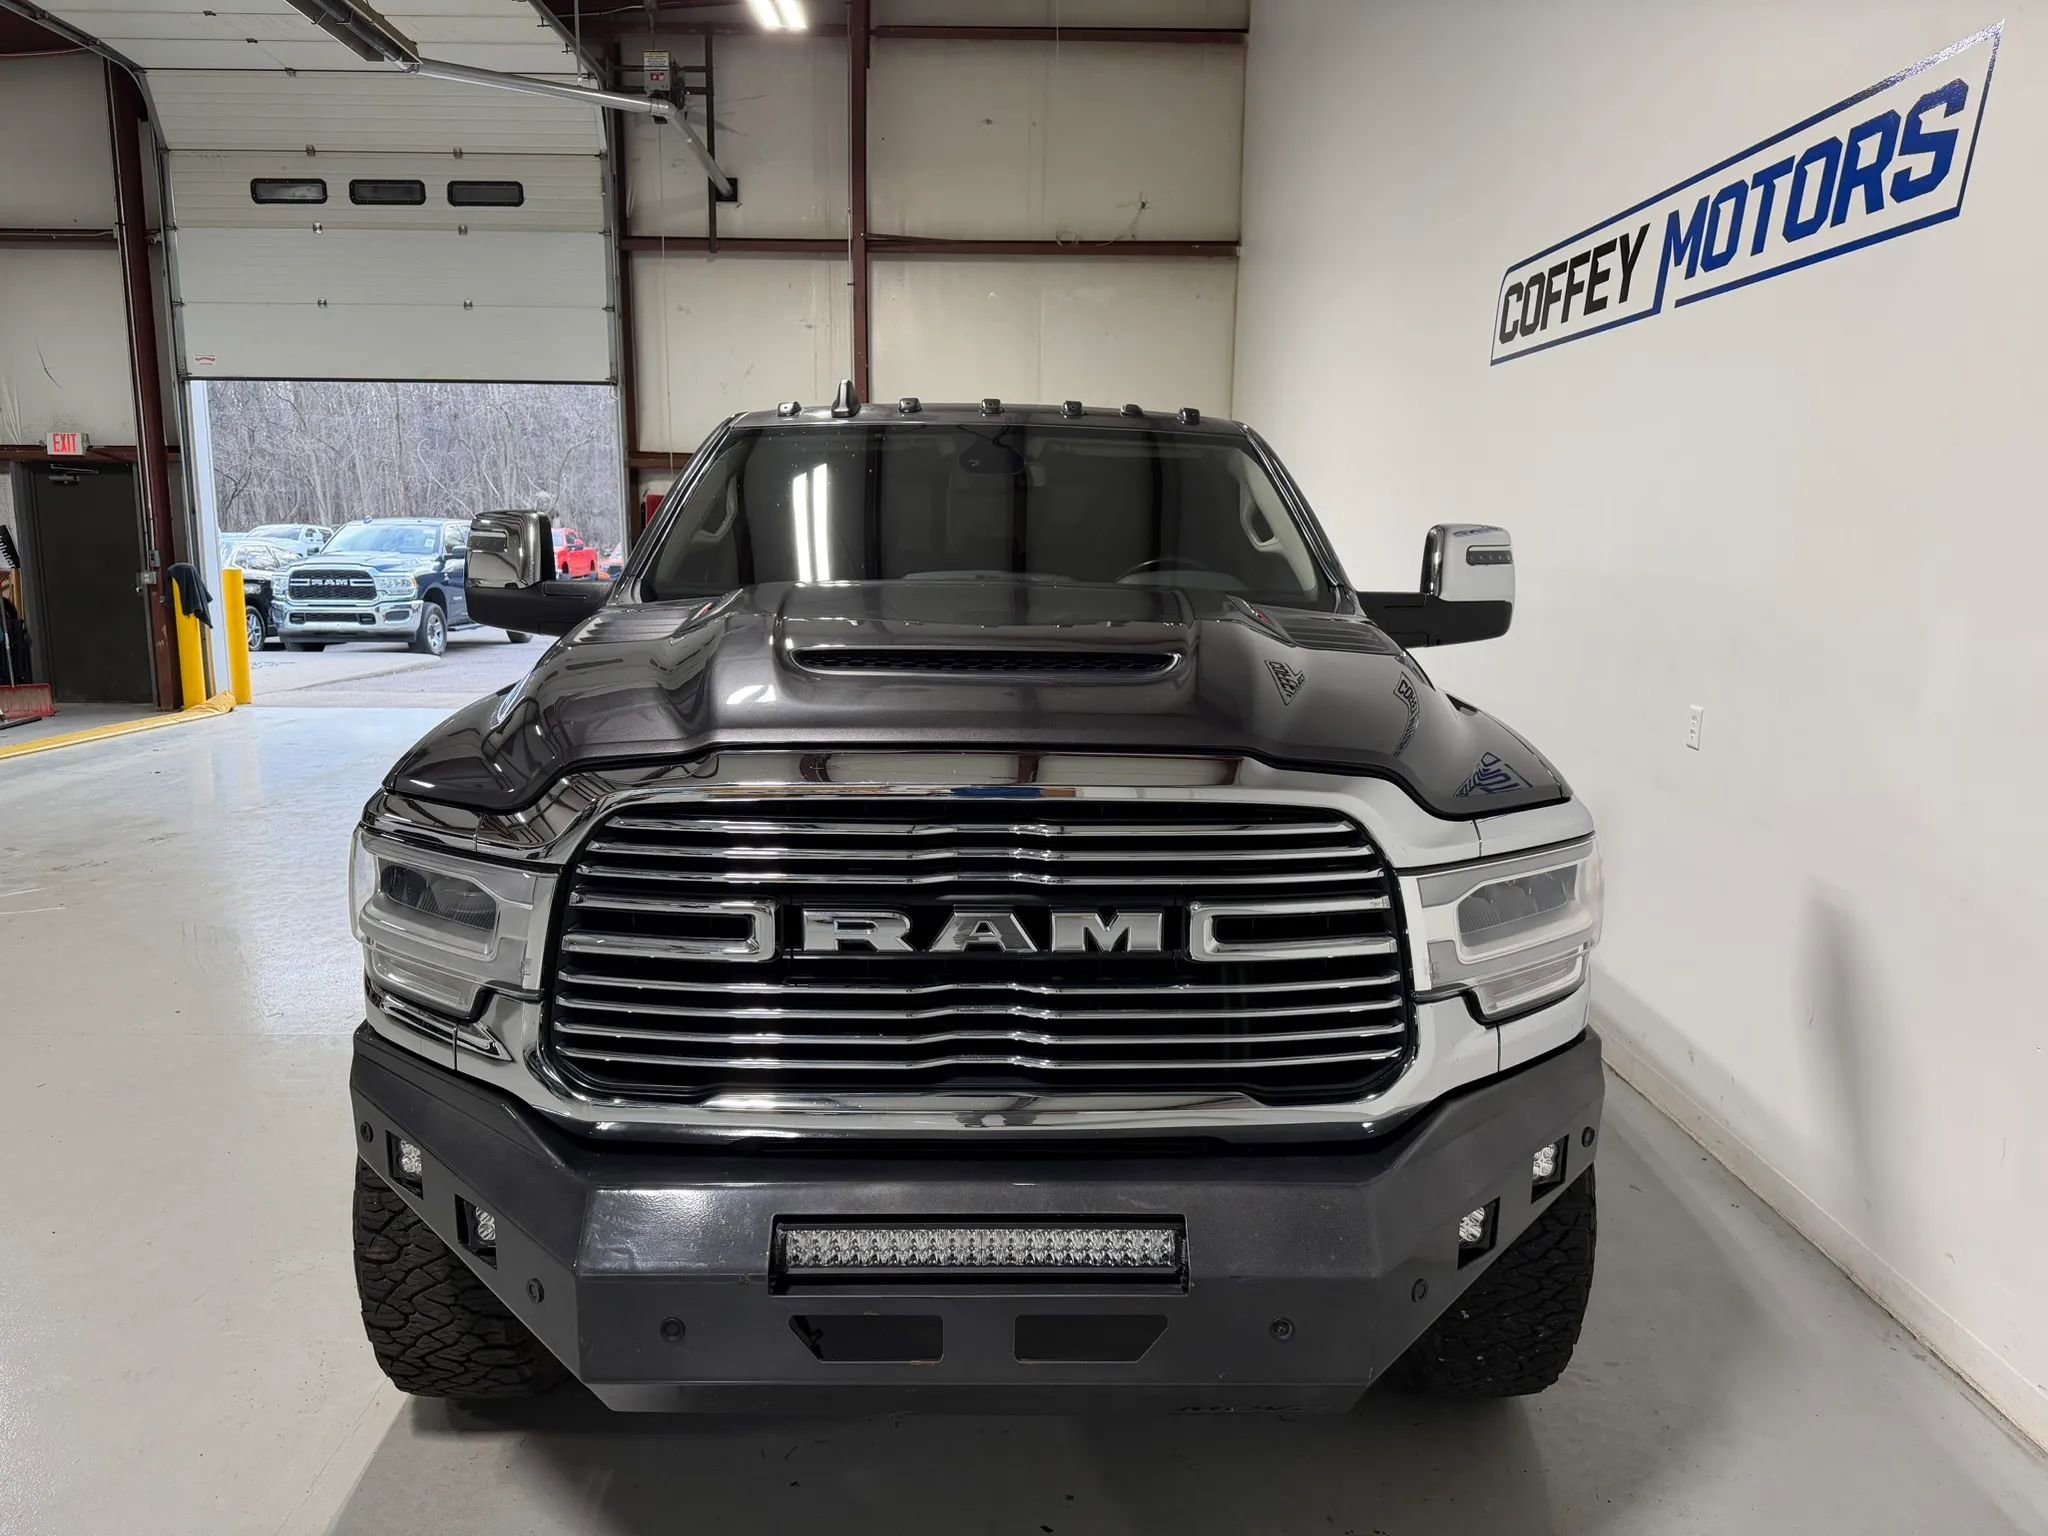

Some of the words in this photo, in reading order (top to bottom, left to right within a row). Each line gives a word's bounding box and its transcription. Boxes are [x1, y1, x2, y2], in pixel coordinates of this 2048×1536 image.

[1498, 223, 1650, 344] COFFEY
[1661, 78, 1969, 282] MOTORS
[53, 433, 77, 453] EXIT
[802, 908, 1164, 952] RAM
